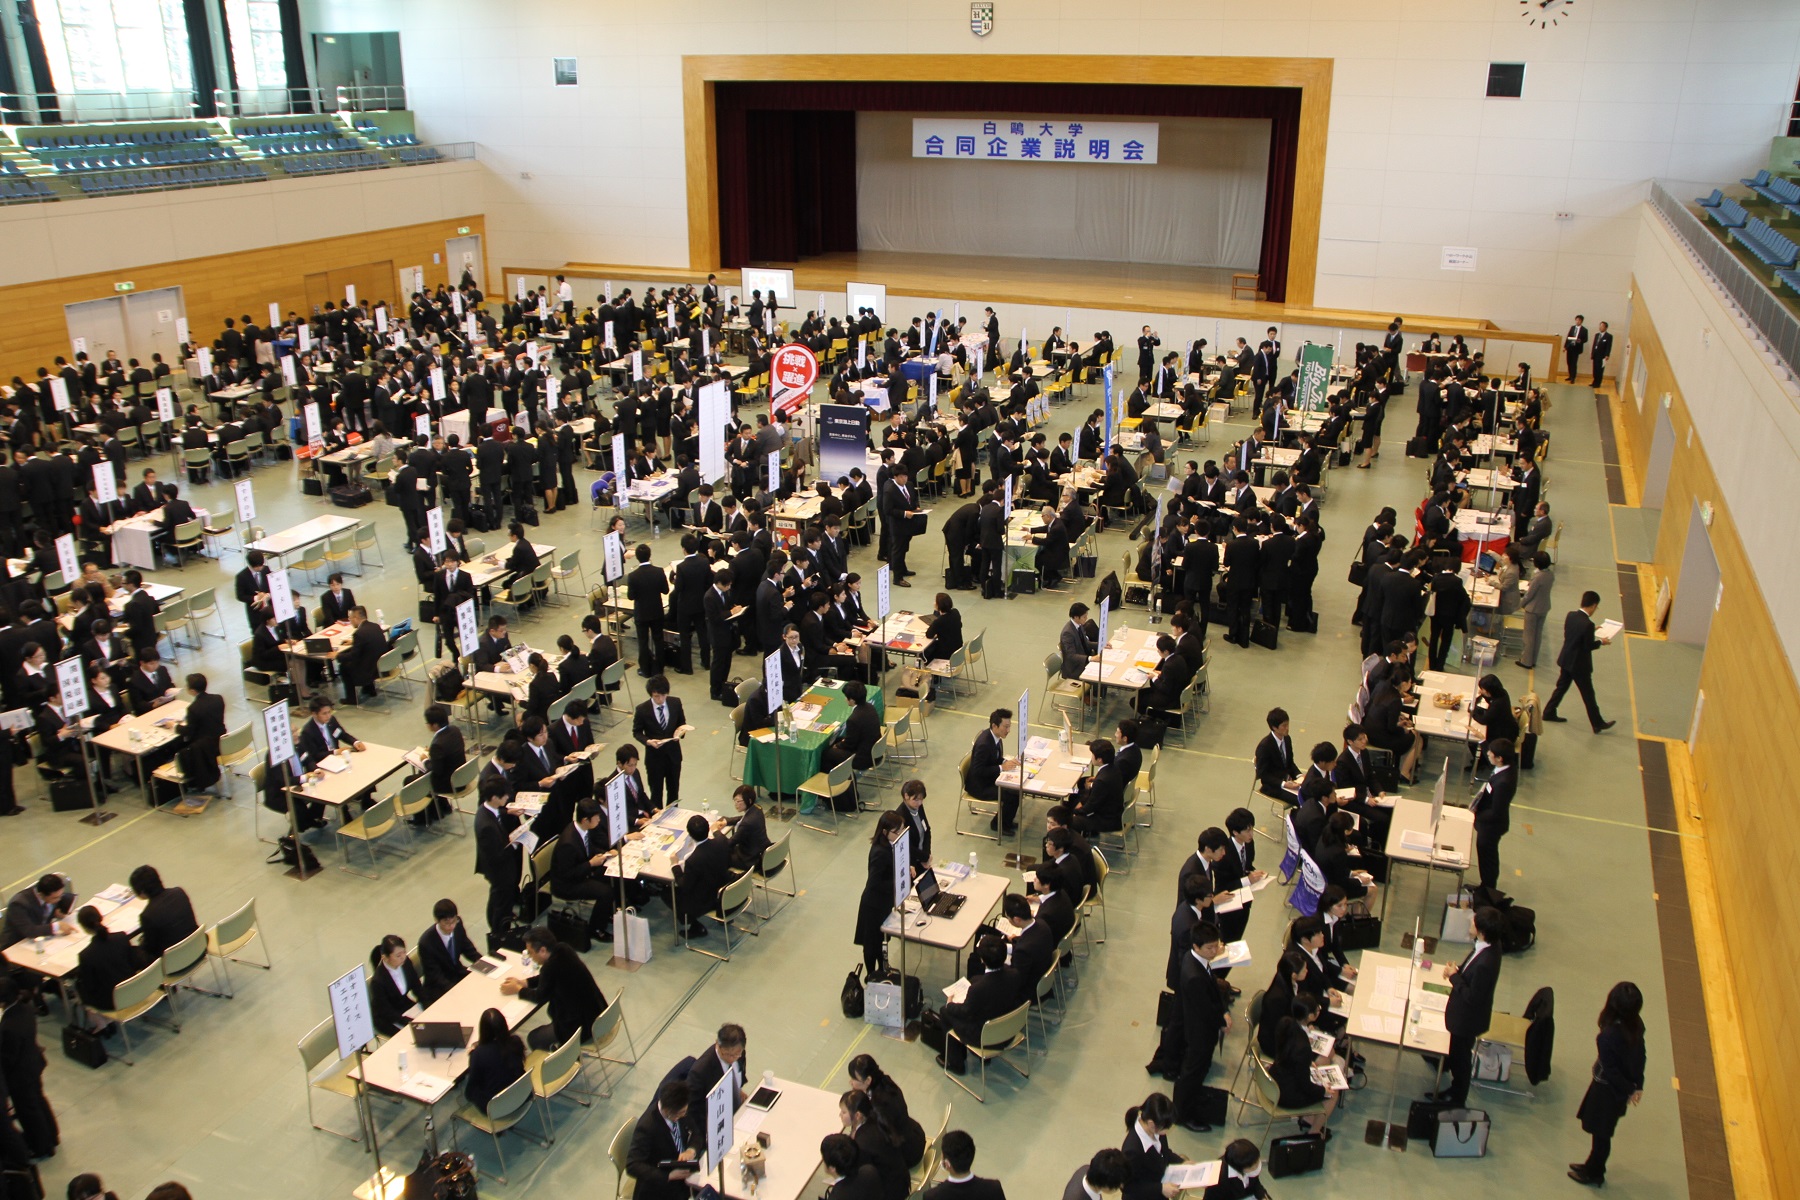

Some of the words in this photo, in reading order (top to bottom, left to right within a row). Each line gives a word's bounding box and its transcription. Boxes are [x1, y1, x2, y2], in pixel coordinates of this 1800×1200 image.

[925, 135, 1145, 160] 合同企業説明会
[783, 352, 806, 368] 挑戦
[782, 372, 805, 386] 躍進
[1310, 361, 1327, 386] Big
[466, 606, 474, 634] 埼玉県
